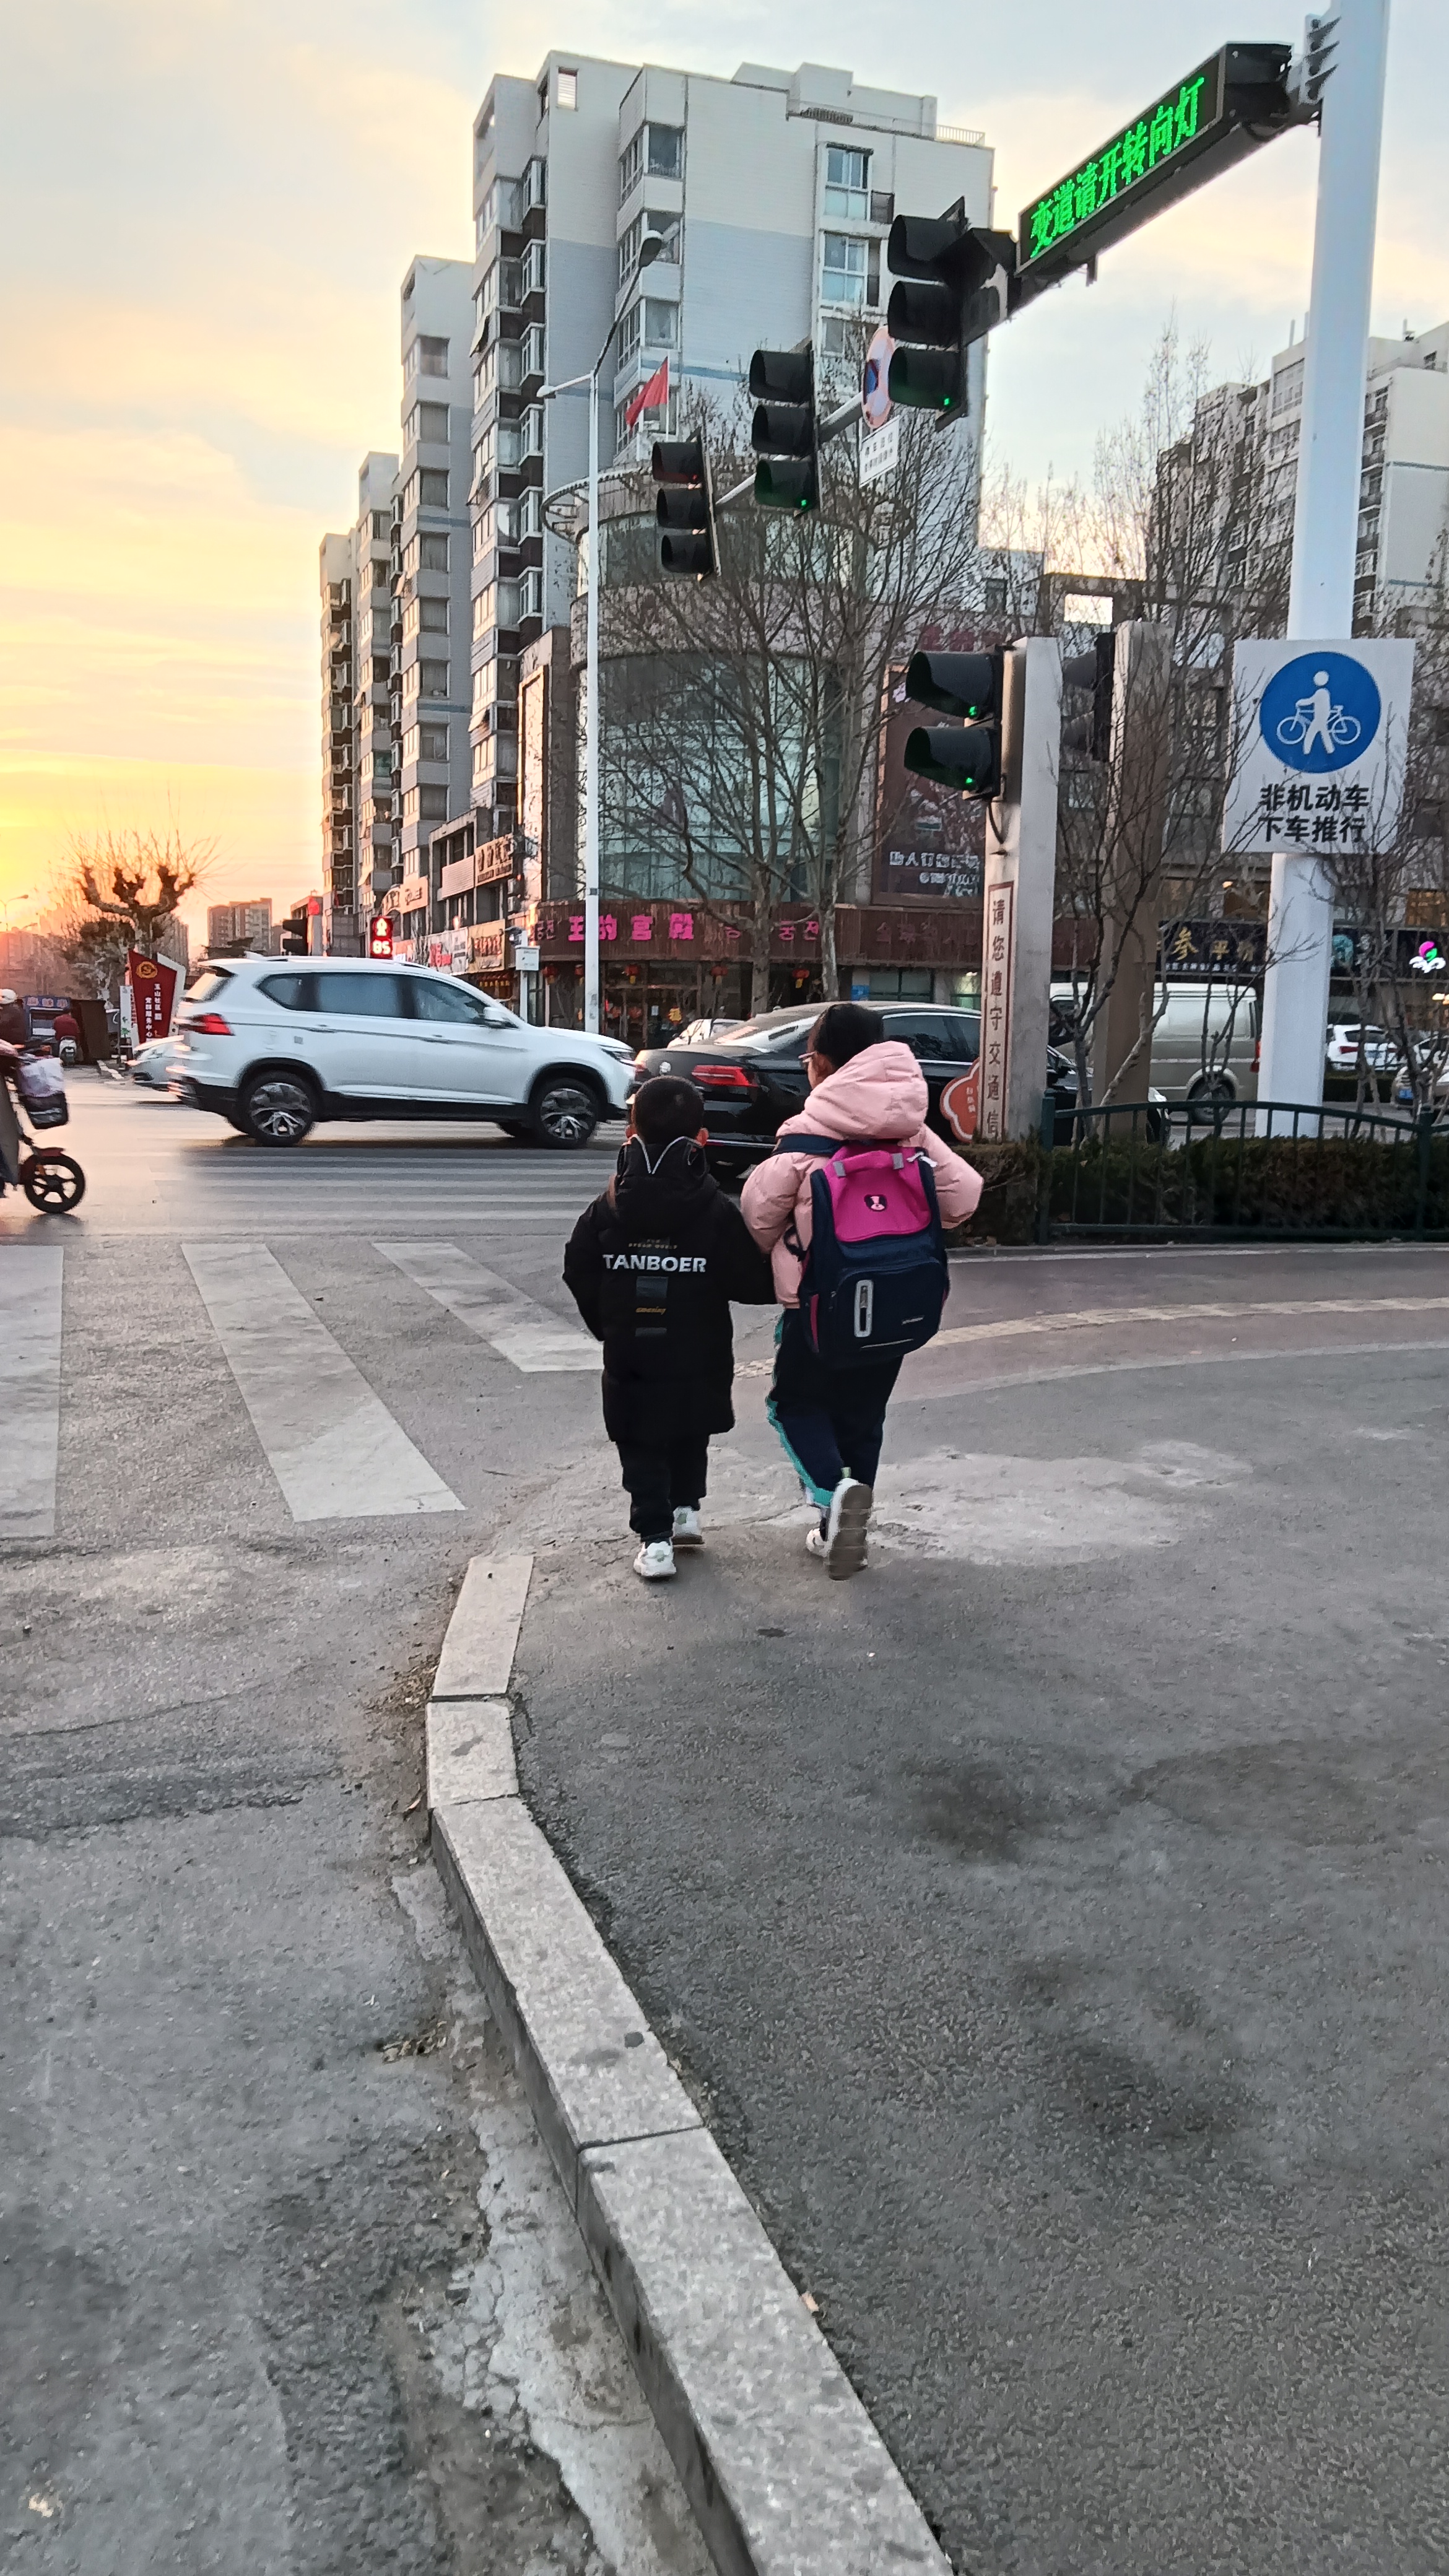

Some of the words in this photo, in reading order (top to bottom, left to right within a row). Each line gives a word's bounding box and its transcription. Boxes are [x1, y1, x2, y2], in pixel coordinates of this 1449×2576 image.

[1030, 77, 1205, 259] 变道请开转向灯
[1258, 783, 1369, 812] 非机动车
[1258, 815, 1366, 843] 下车推行
[373, 940, 391, 955] 85
[602, 1254, 707, 1273] TANBOER
